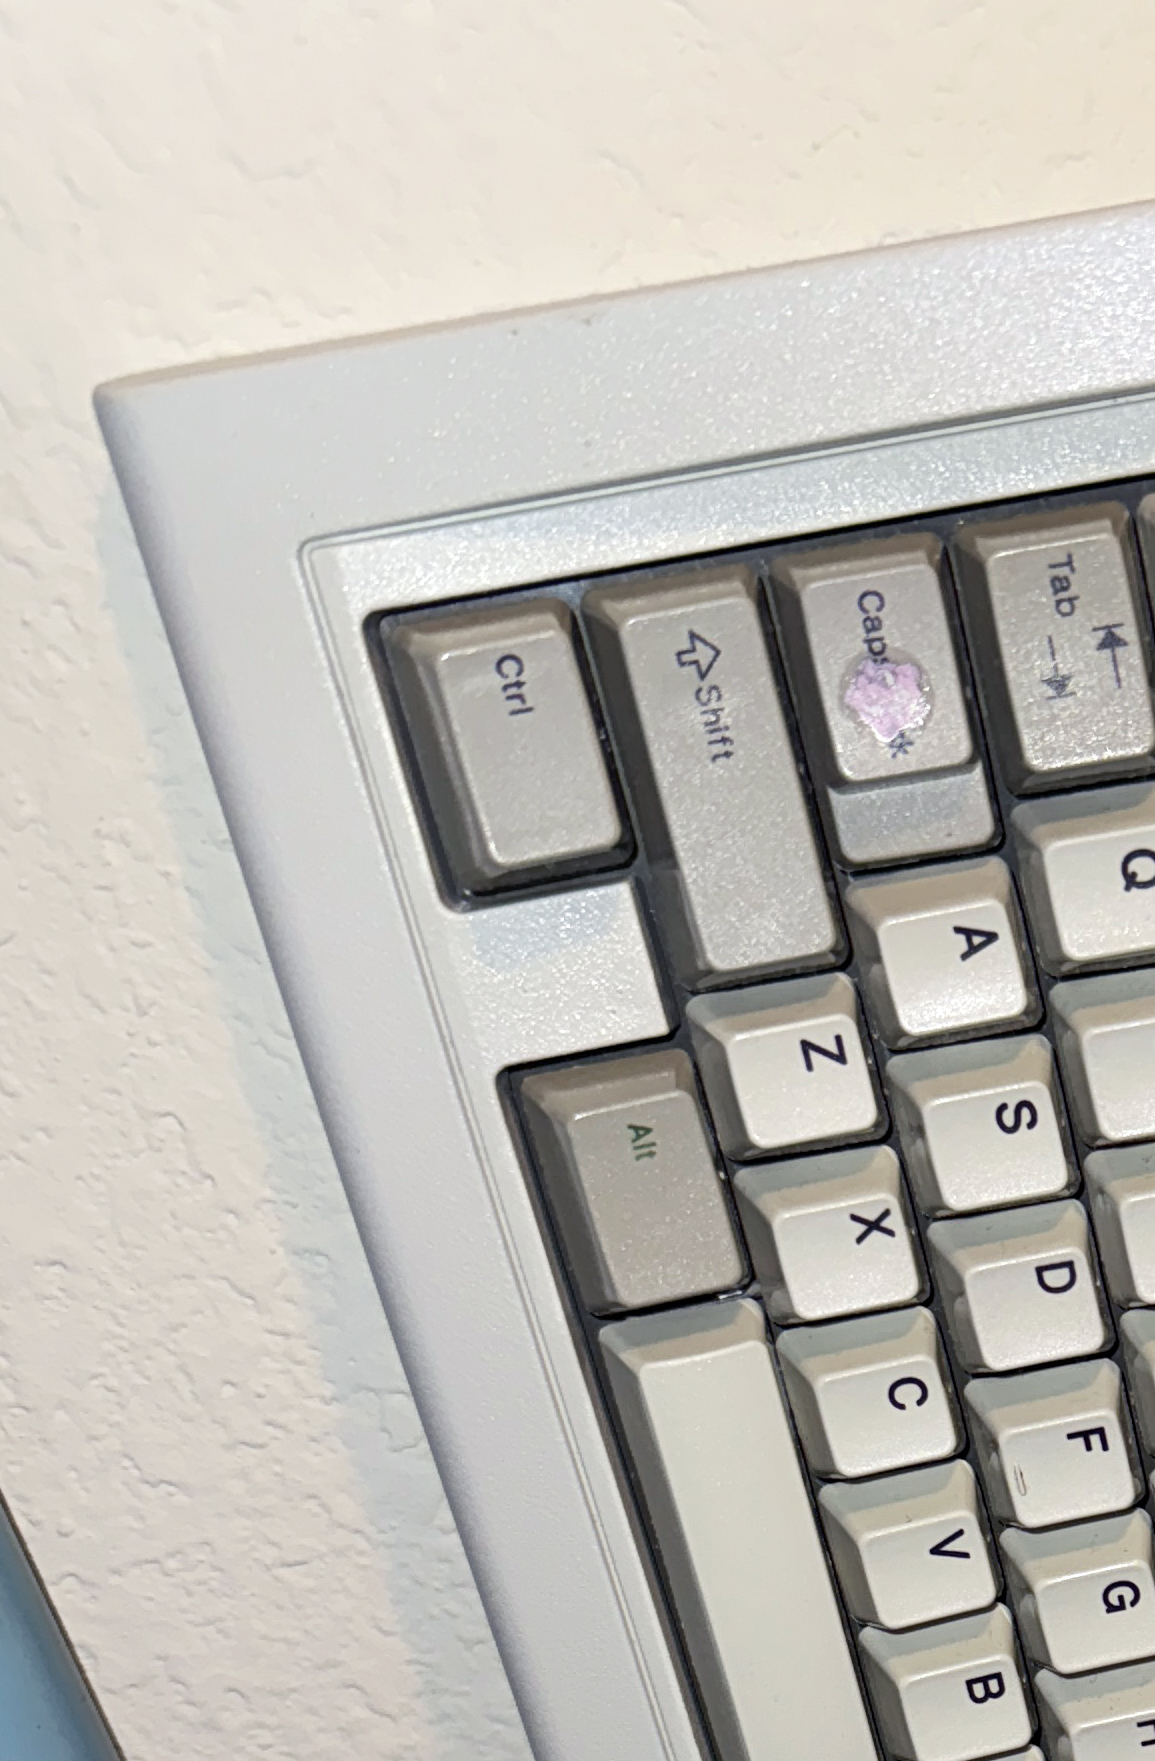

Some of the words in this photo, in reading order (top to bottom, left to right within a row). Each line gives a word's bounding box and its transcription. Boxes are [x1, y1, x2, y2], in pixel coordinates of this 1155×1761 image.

[1047, 553, 1080, 619] Tab
[494, 653, 534, 717] Ctrl
[693, 685, 736, 764] Shift
[953, 925, 999, 961] A
[799, 1033, 848, 1072] Z
[995, 1099, 1039, 1135] S
[627, 1123, 657, 1162] Alt
[849, 1208, 896, 1245] X
[1035, 1260, 1077, 1294] D
[888, 1376, 929, 1410] C
[1067, 1426, 1109, 1453] F
[929, 1528, 971, 1559] V
[1102, 1579, 1141, 1614] G
[965, 1671, 1006, 1704] B
